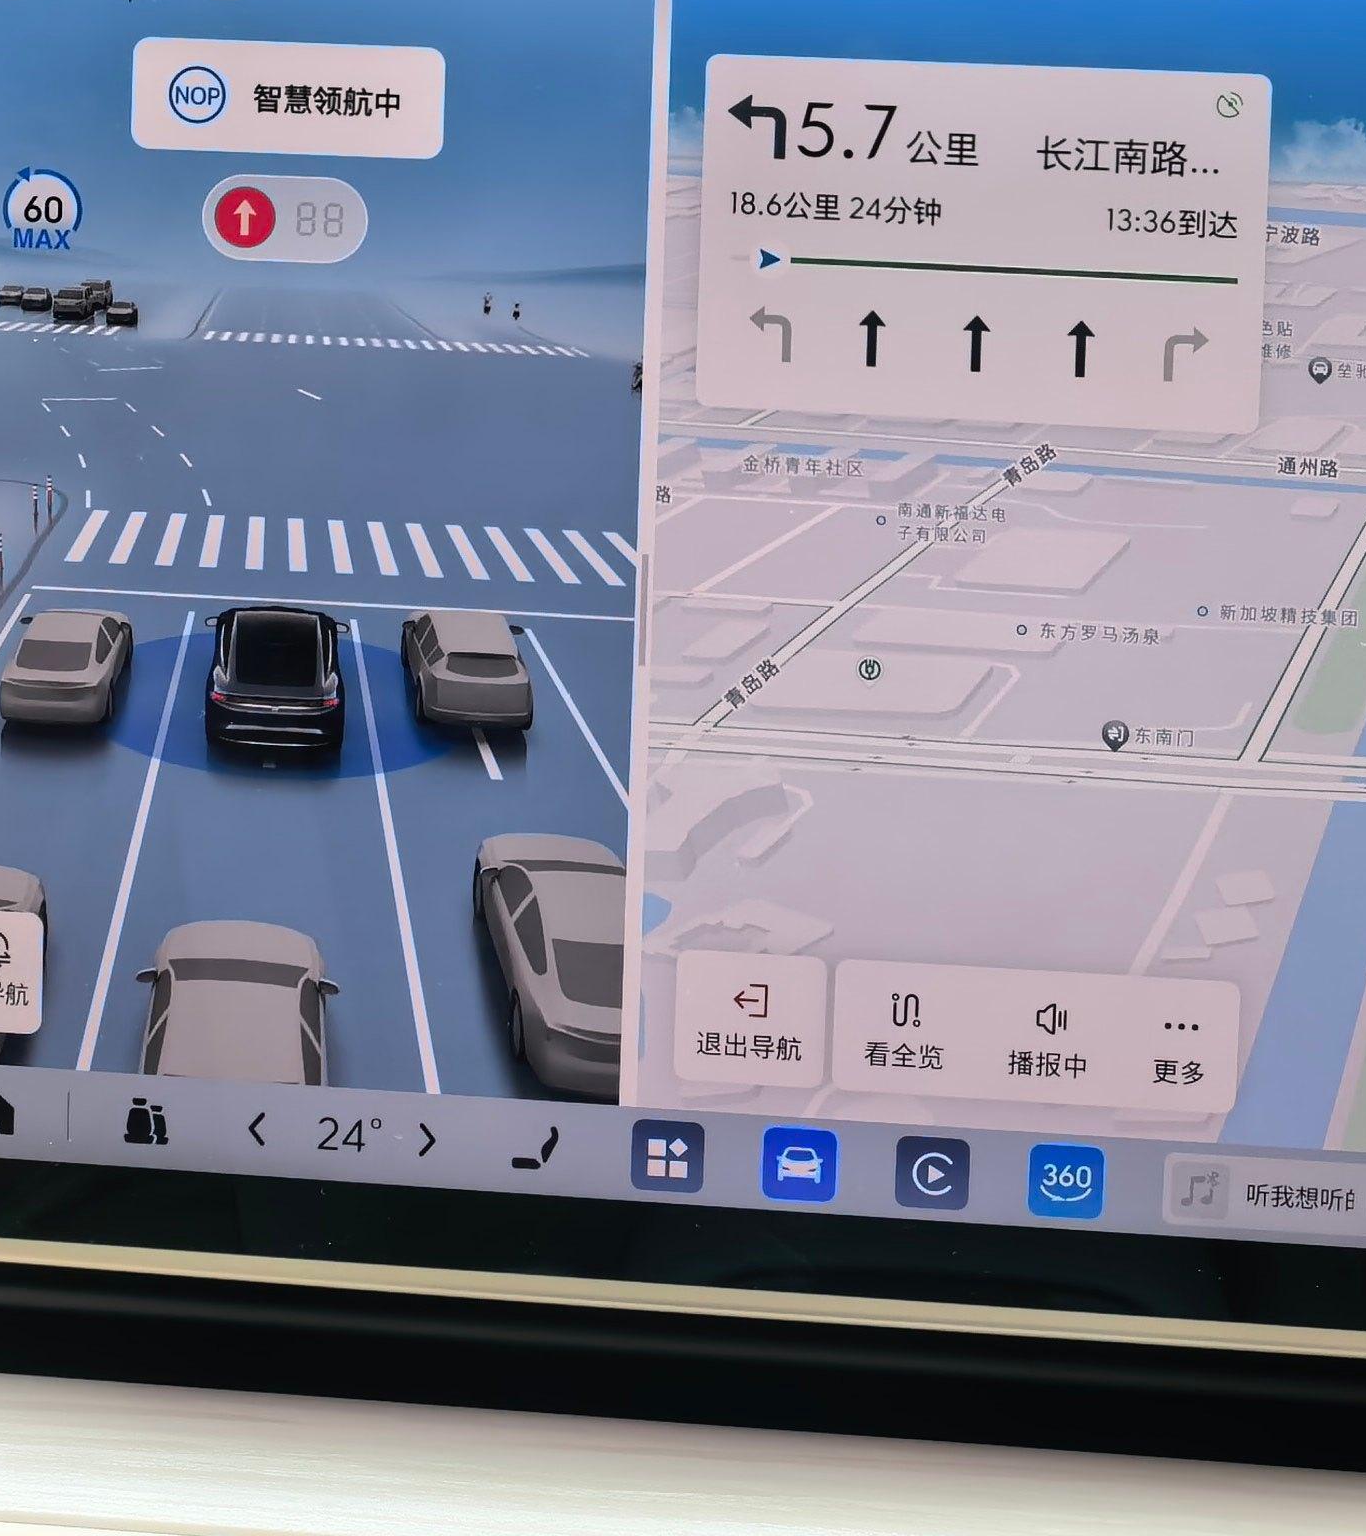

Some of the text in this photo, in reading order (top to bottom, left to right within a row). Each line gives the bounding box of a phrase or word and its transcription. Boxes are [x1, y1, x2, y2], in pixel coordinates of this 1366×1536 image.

[175, 85, 220, 106] NOP
[253, 84, 401, 118] 智慧领航中
[796, 103, 979, 167] 5.7 公里
[23, 195, 63, 224] 60
[730, 191, 942, 225] 18.6公里 24分钟
[1107, 207, 1239, 239] 13:36到达
[13, 228, 71, 250] MAX
[743, 454, 864, 477] 金桥青年社区
[1003, 443, 1057, 487] 青岛路
[1278, 457, 1338, 478] 通州路
[897, 503, 1005, 522] 南通新福达电
[897, 525, 987, 544] 子有限公司
[1220, 604, 1358, 627] 新加坡精技集团
[1040, 622, 1160, 645] 东方罗马汤泉
[725, 657, 781, 709] 青岛路
[1135, 728, 1194, 747] 东南门
[696, 1032, 802, 1062] 退出导航
[864, 1042, 943, 1071] 看全览
[1008, 1050, 1086, 1079] 播报中
[1153, 1059, 1204, 1086] 更多
[1042, 1164, 1091, 1187] 360
